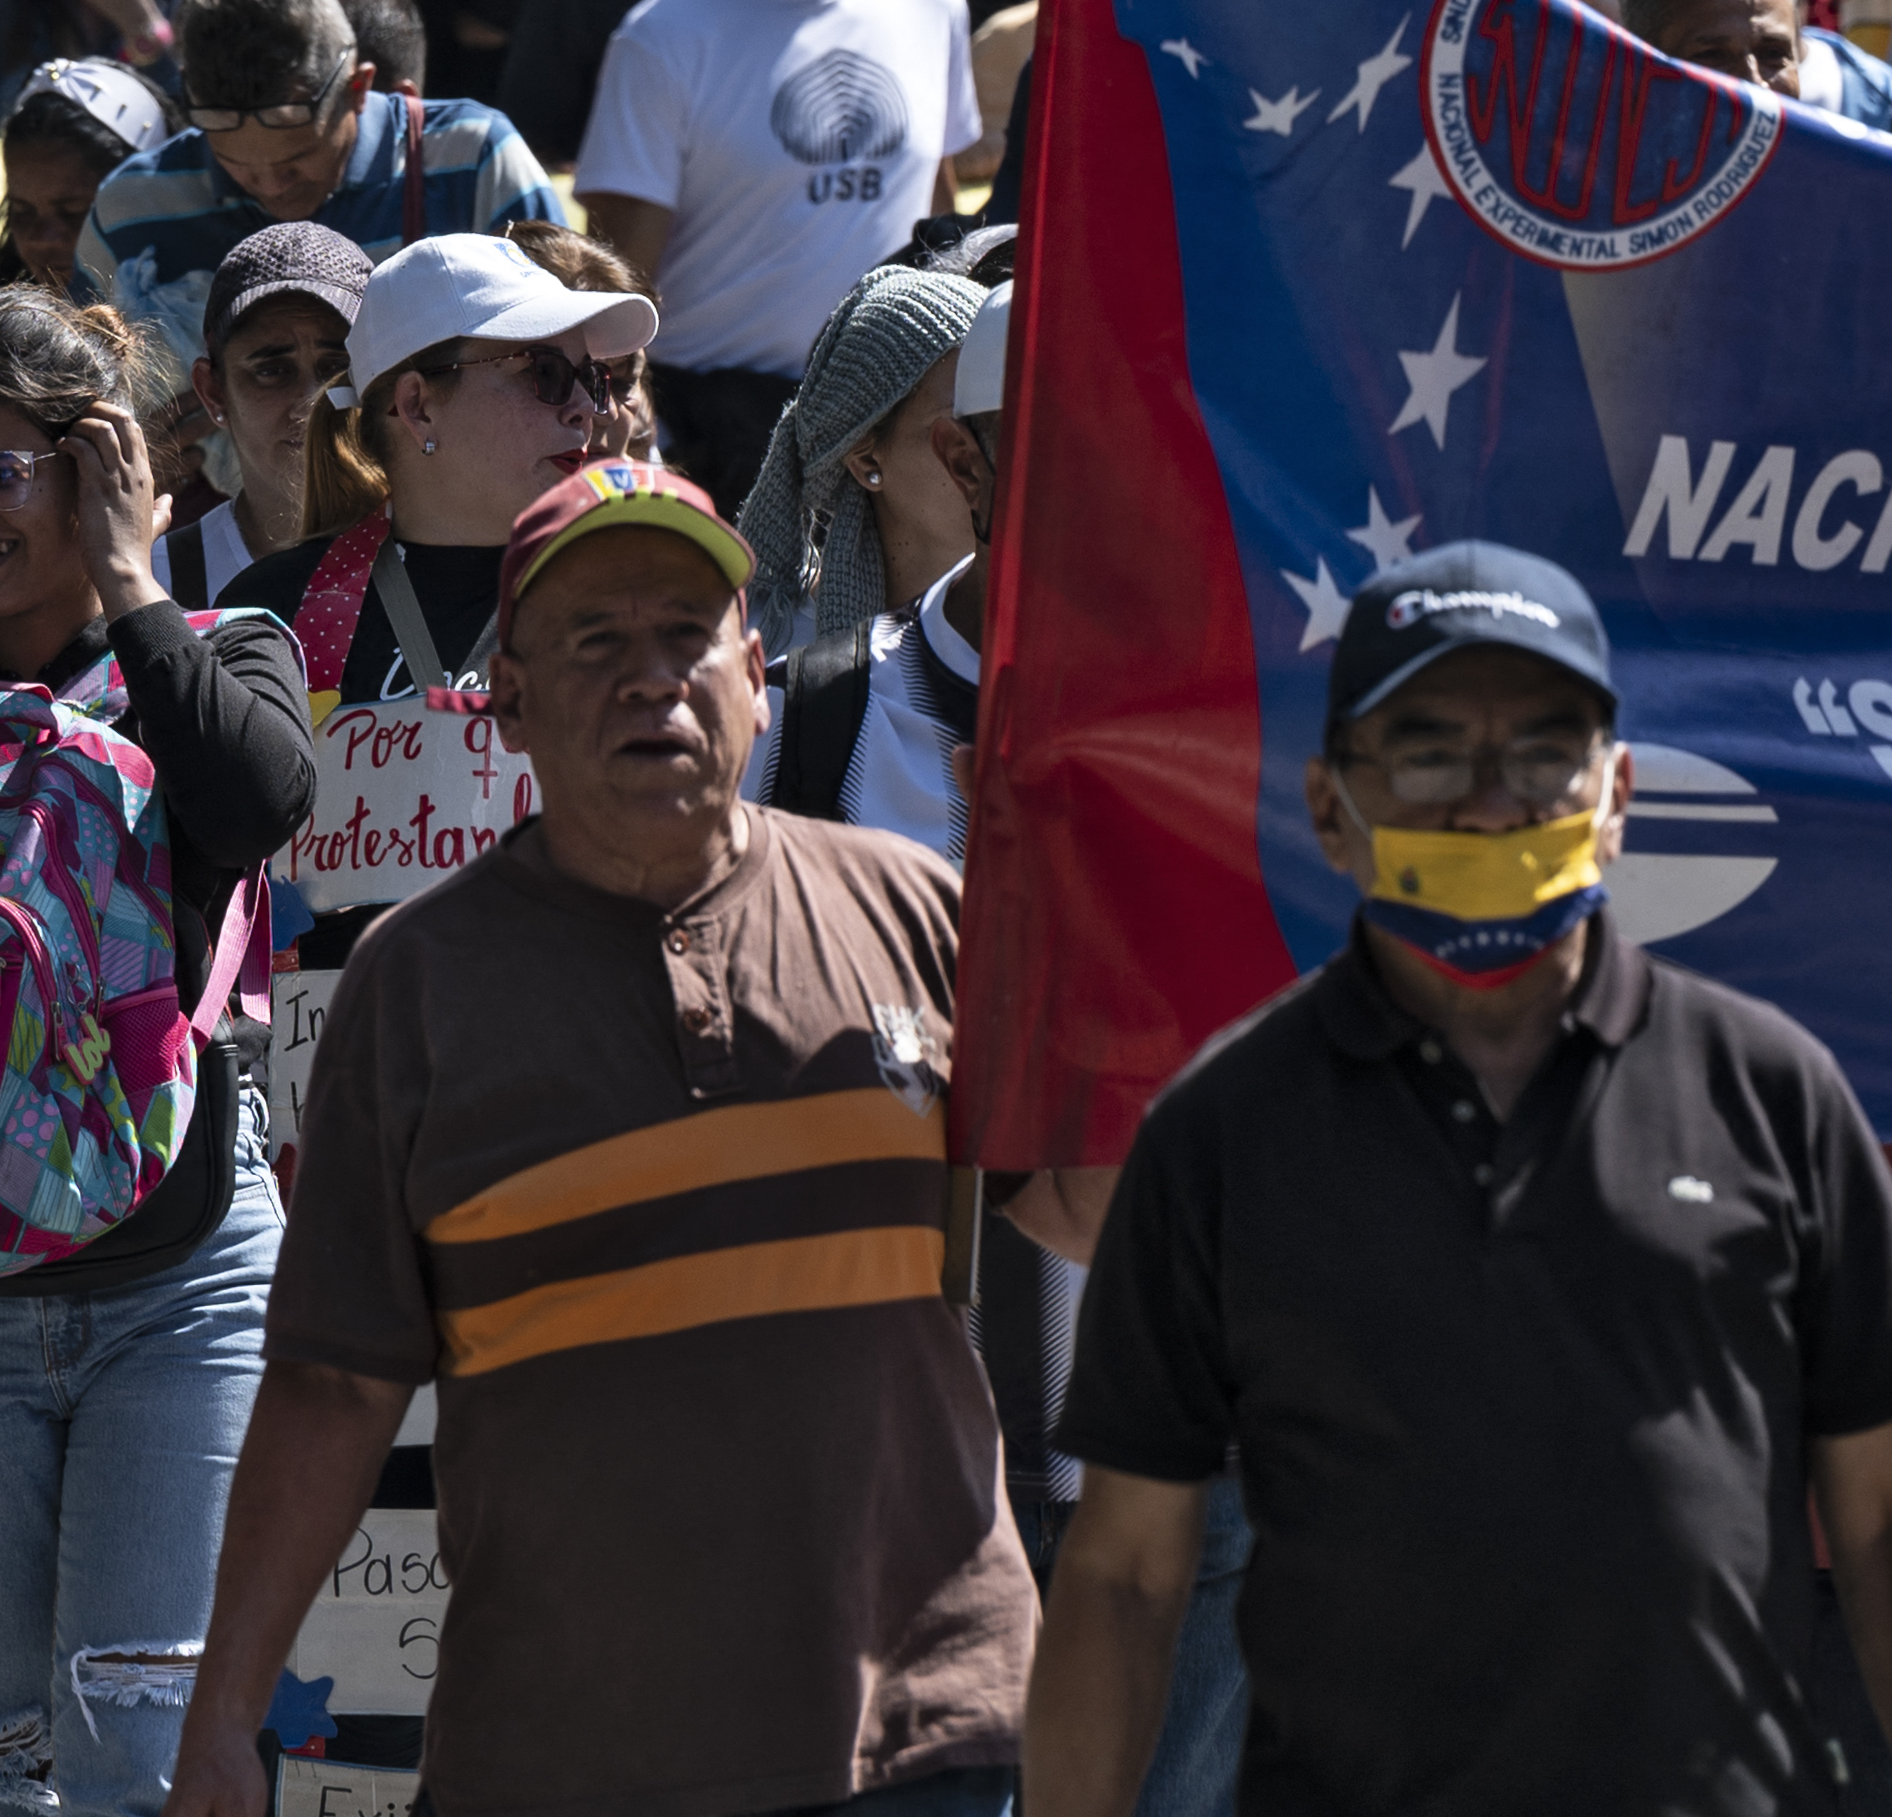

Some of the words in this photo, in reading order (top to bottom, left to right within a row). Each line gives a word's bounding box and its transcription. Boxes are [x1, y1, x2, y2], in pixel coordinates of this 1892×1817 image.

[807, 167, 883, 205] USB
[1437, 72, 1478, 189] NACIONAL
[1474, 186, 1621, 260] EXPERIMENTAL
[1628, 211, 1694, 256] SIMON
[1693, 110, 1777, 220] RODRIGUEZ
[326, 709, 423, 770] Por
